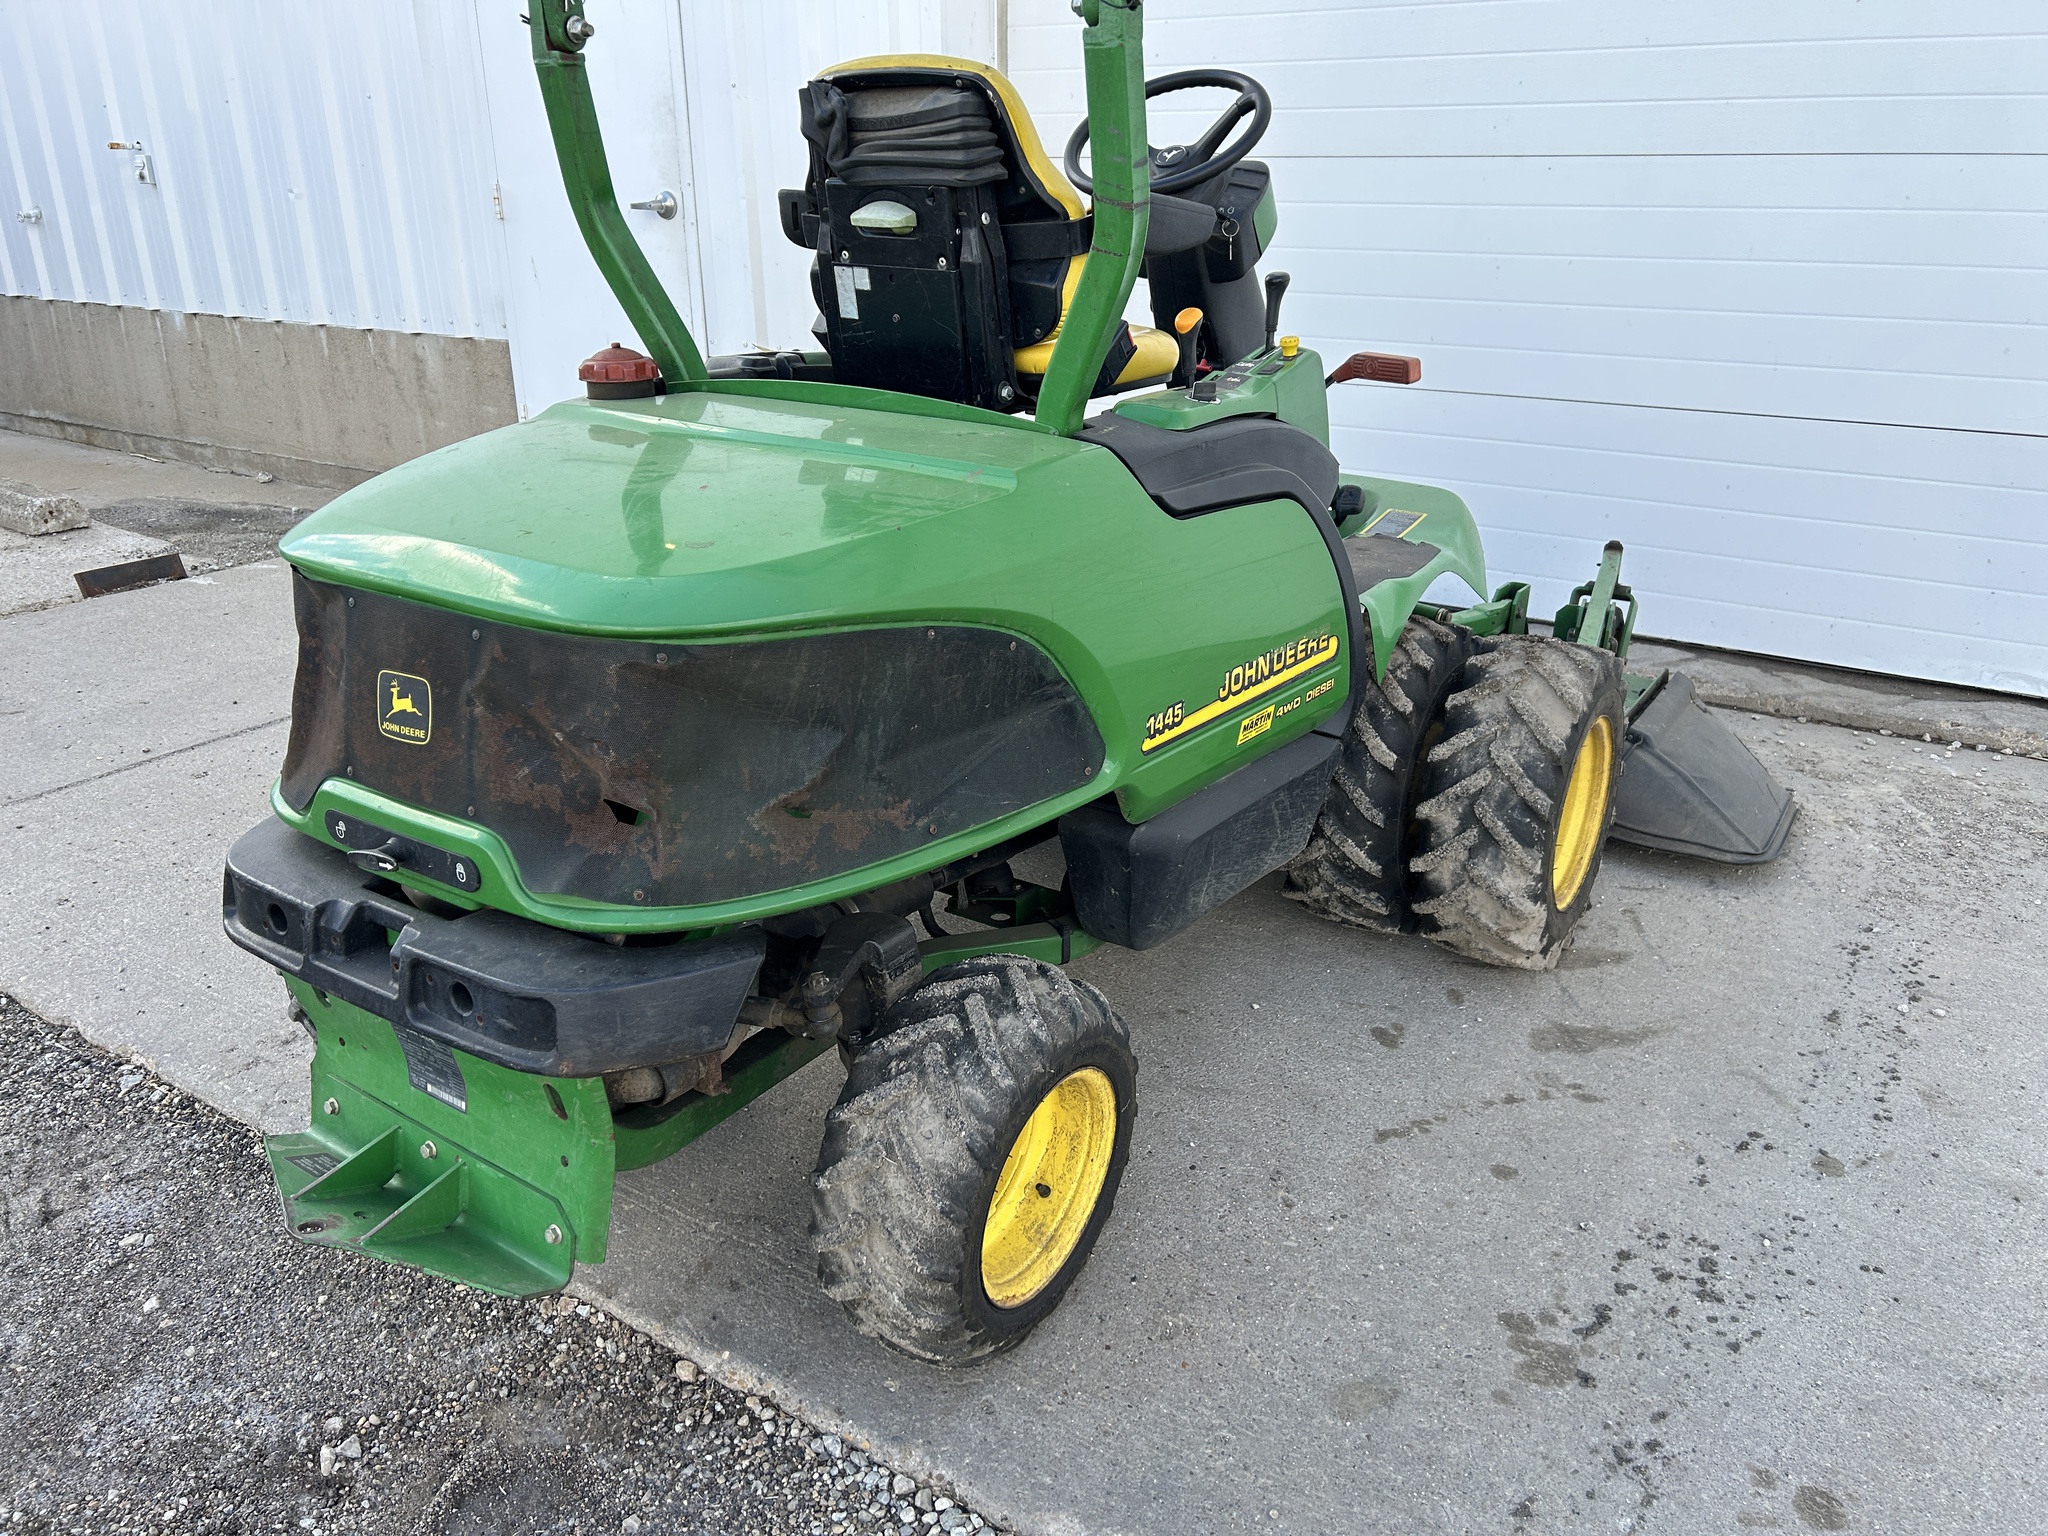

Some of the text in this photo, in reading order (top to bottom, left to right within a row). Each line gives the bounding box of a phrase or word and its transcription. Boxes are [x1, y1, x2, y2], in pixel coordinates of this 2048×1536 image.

[1219, 652, 1271, 699] JOHN
[1276, 696, 1302, 717] 4WD
[382, 721, 426, 738] JOHN DEERE
[1145, 702, 1184, 735] 1445
[1241, 711, 1273, 734] MARTIN
